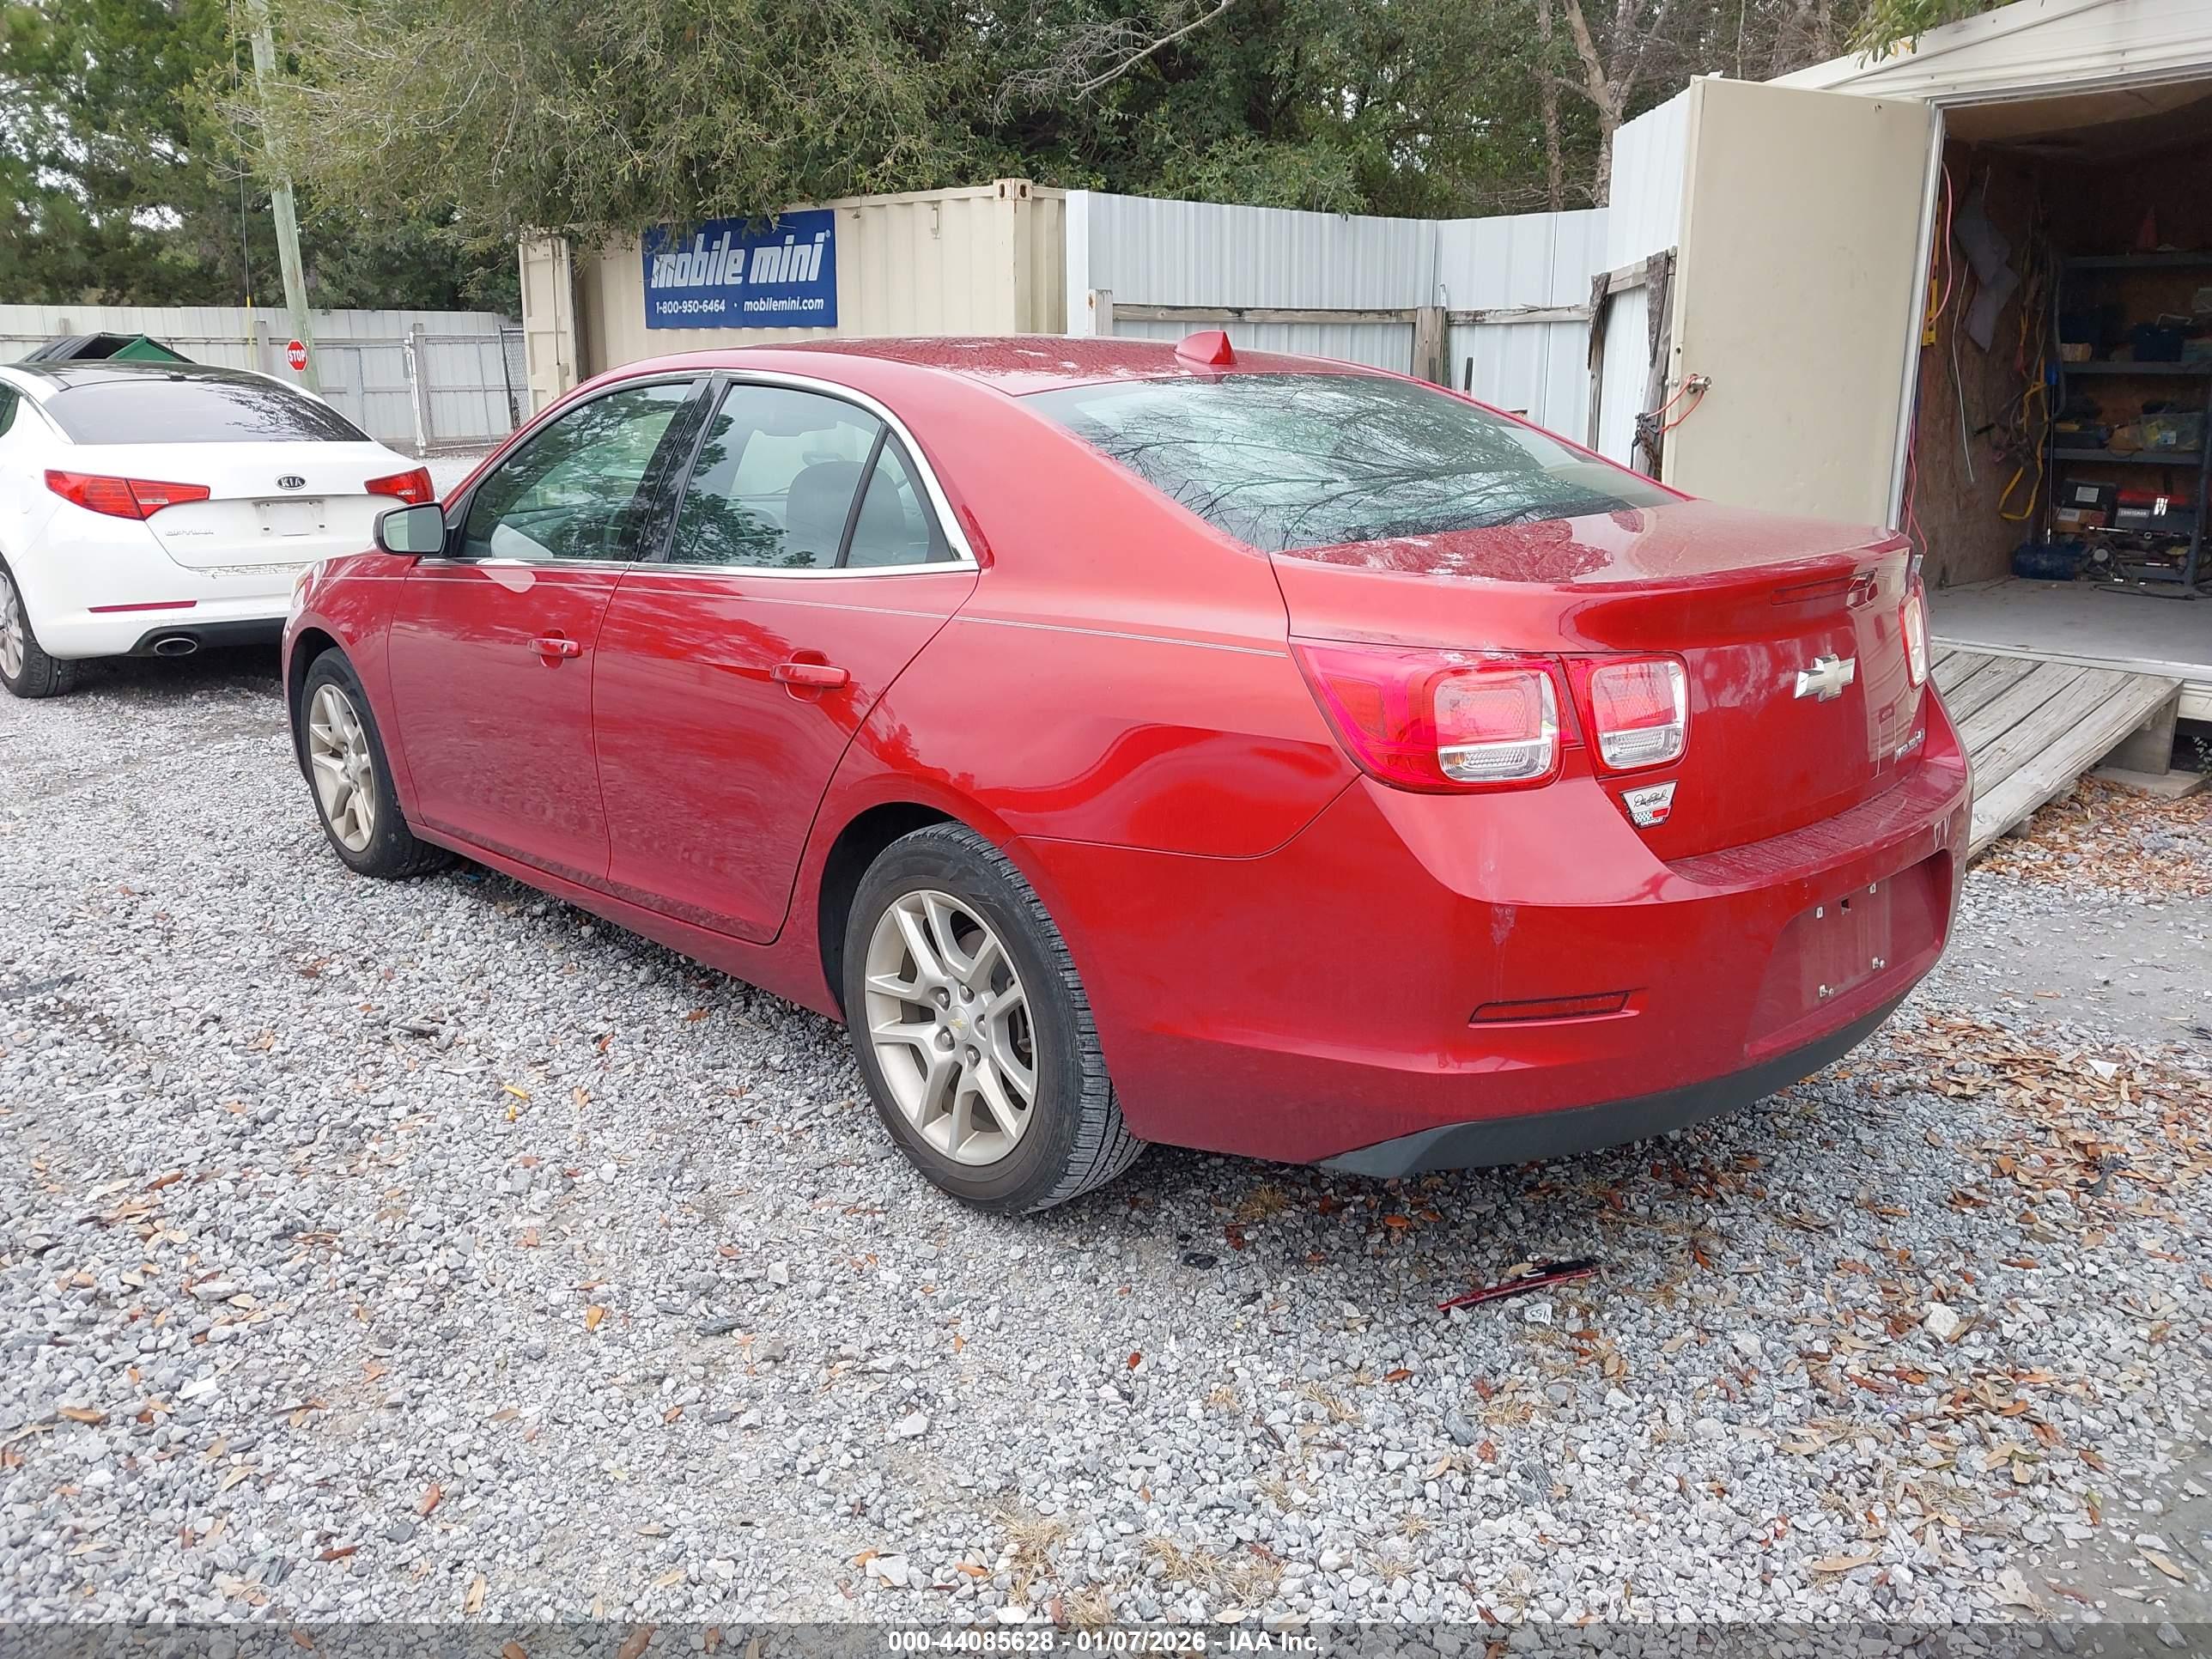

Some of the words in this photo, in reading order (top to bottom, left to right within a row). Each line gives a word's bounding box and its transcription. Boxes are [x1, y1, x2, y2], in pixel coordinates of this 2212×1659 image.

[651, 231, 745, 289] mobile
[656, 300, 726, 314] 1-800-950-6464
[744, 296, 824, 313] mobilemini.com
[289, 349, 305, 362] STOP
[281, 477, 303, 487] KIA
